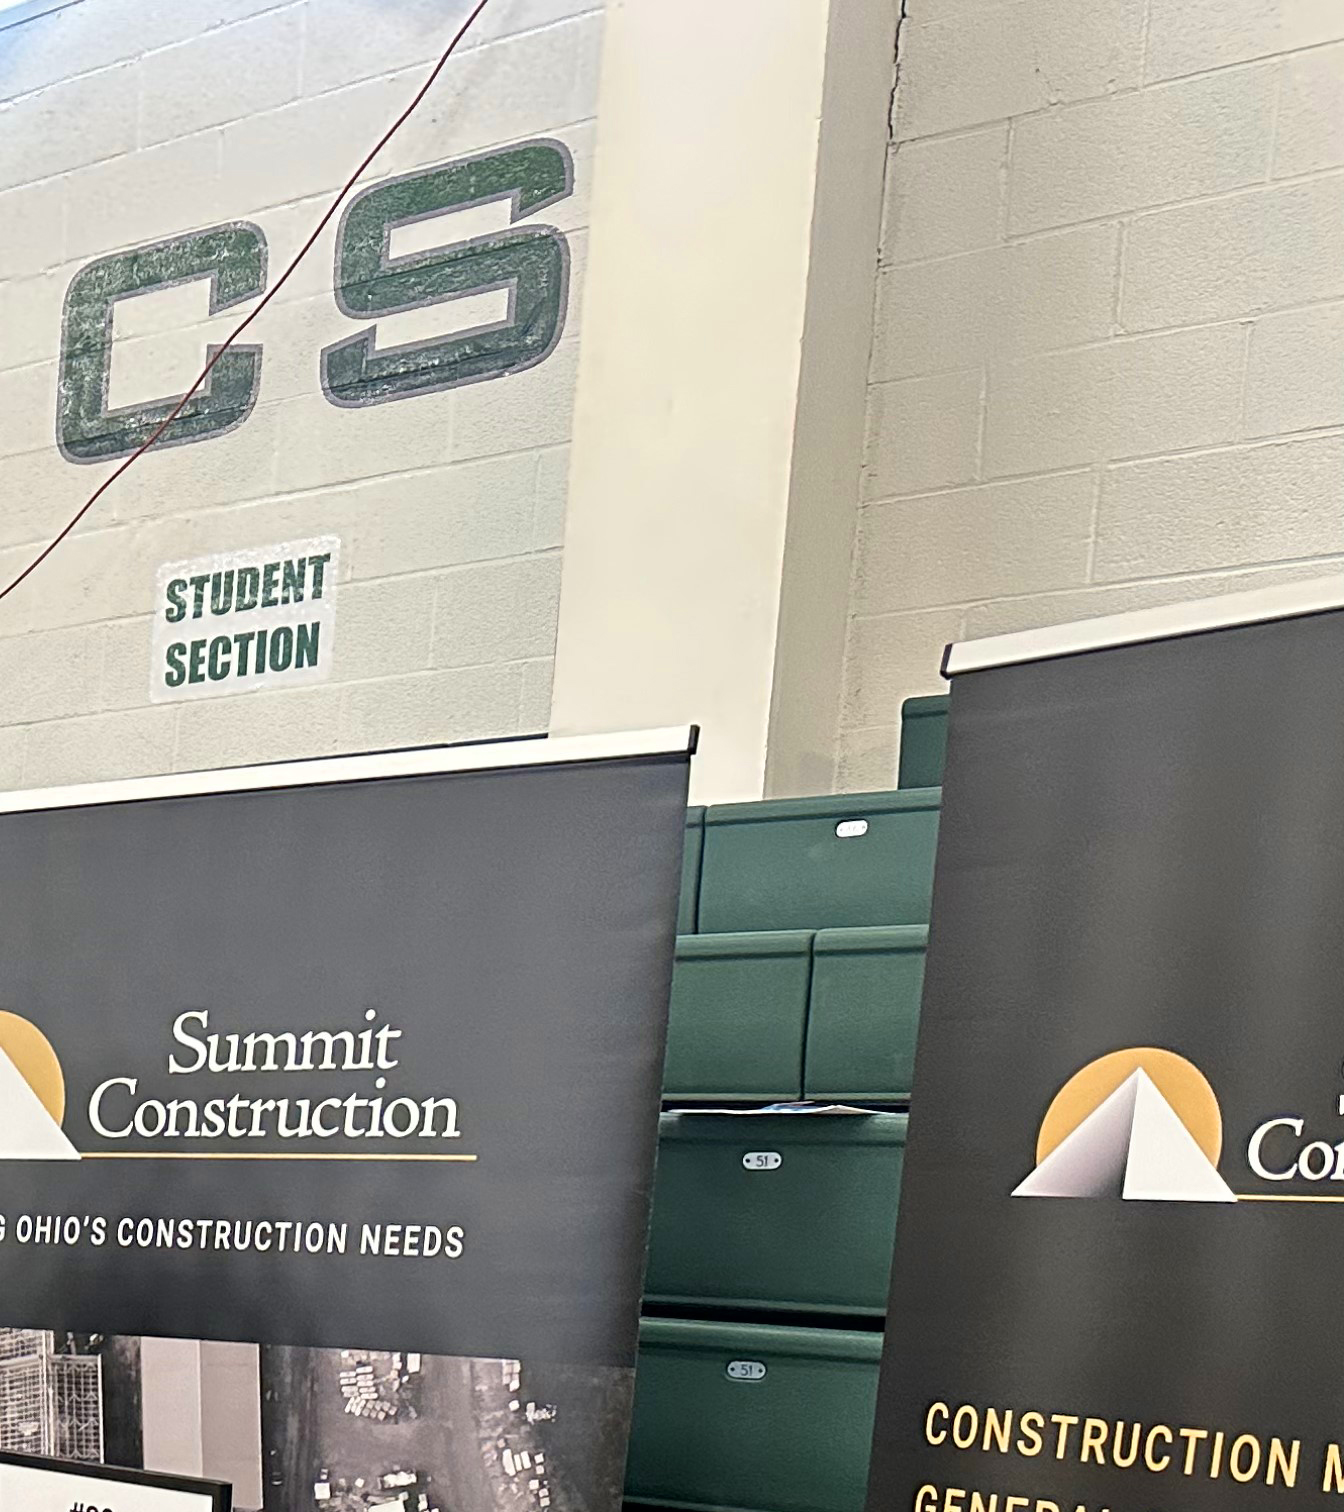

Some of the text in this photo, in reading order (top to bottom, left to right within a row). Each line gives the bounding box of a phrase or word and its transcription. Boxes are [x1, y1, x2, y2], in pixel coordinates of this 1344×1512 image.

[164, 552, 332, 626] STUDENT
[164, 620, 321, 690] SECTION
[167, 1008, 402, 1076] Summit
[87, 1076, 461, 1140] Construction
[755, 1154, 769, 1168] 51
[14, 1213, 108, 1248] OHIO'S
[115, 1216, 348, 1256] CONSTRUCTION
[359, 1224, 466, 1260] NEEDS
[740, 1362, 754, 1377] 51
[925, 1402, 1301, 1489] CONSTRUCTION
